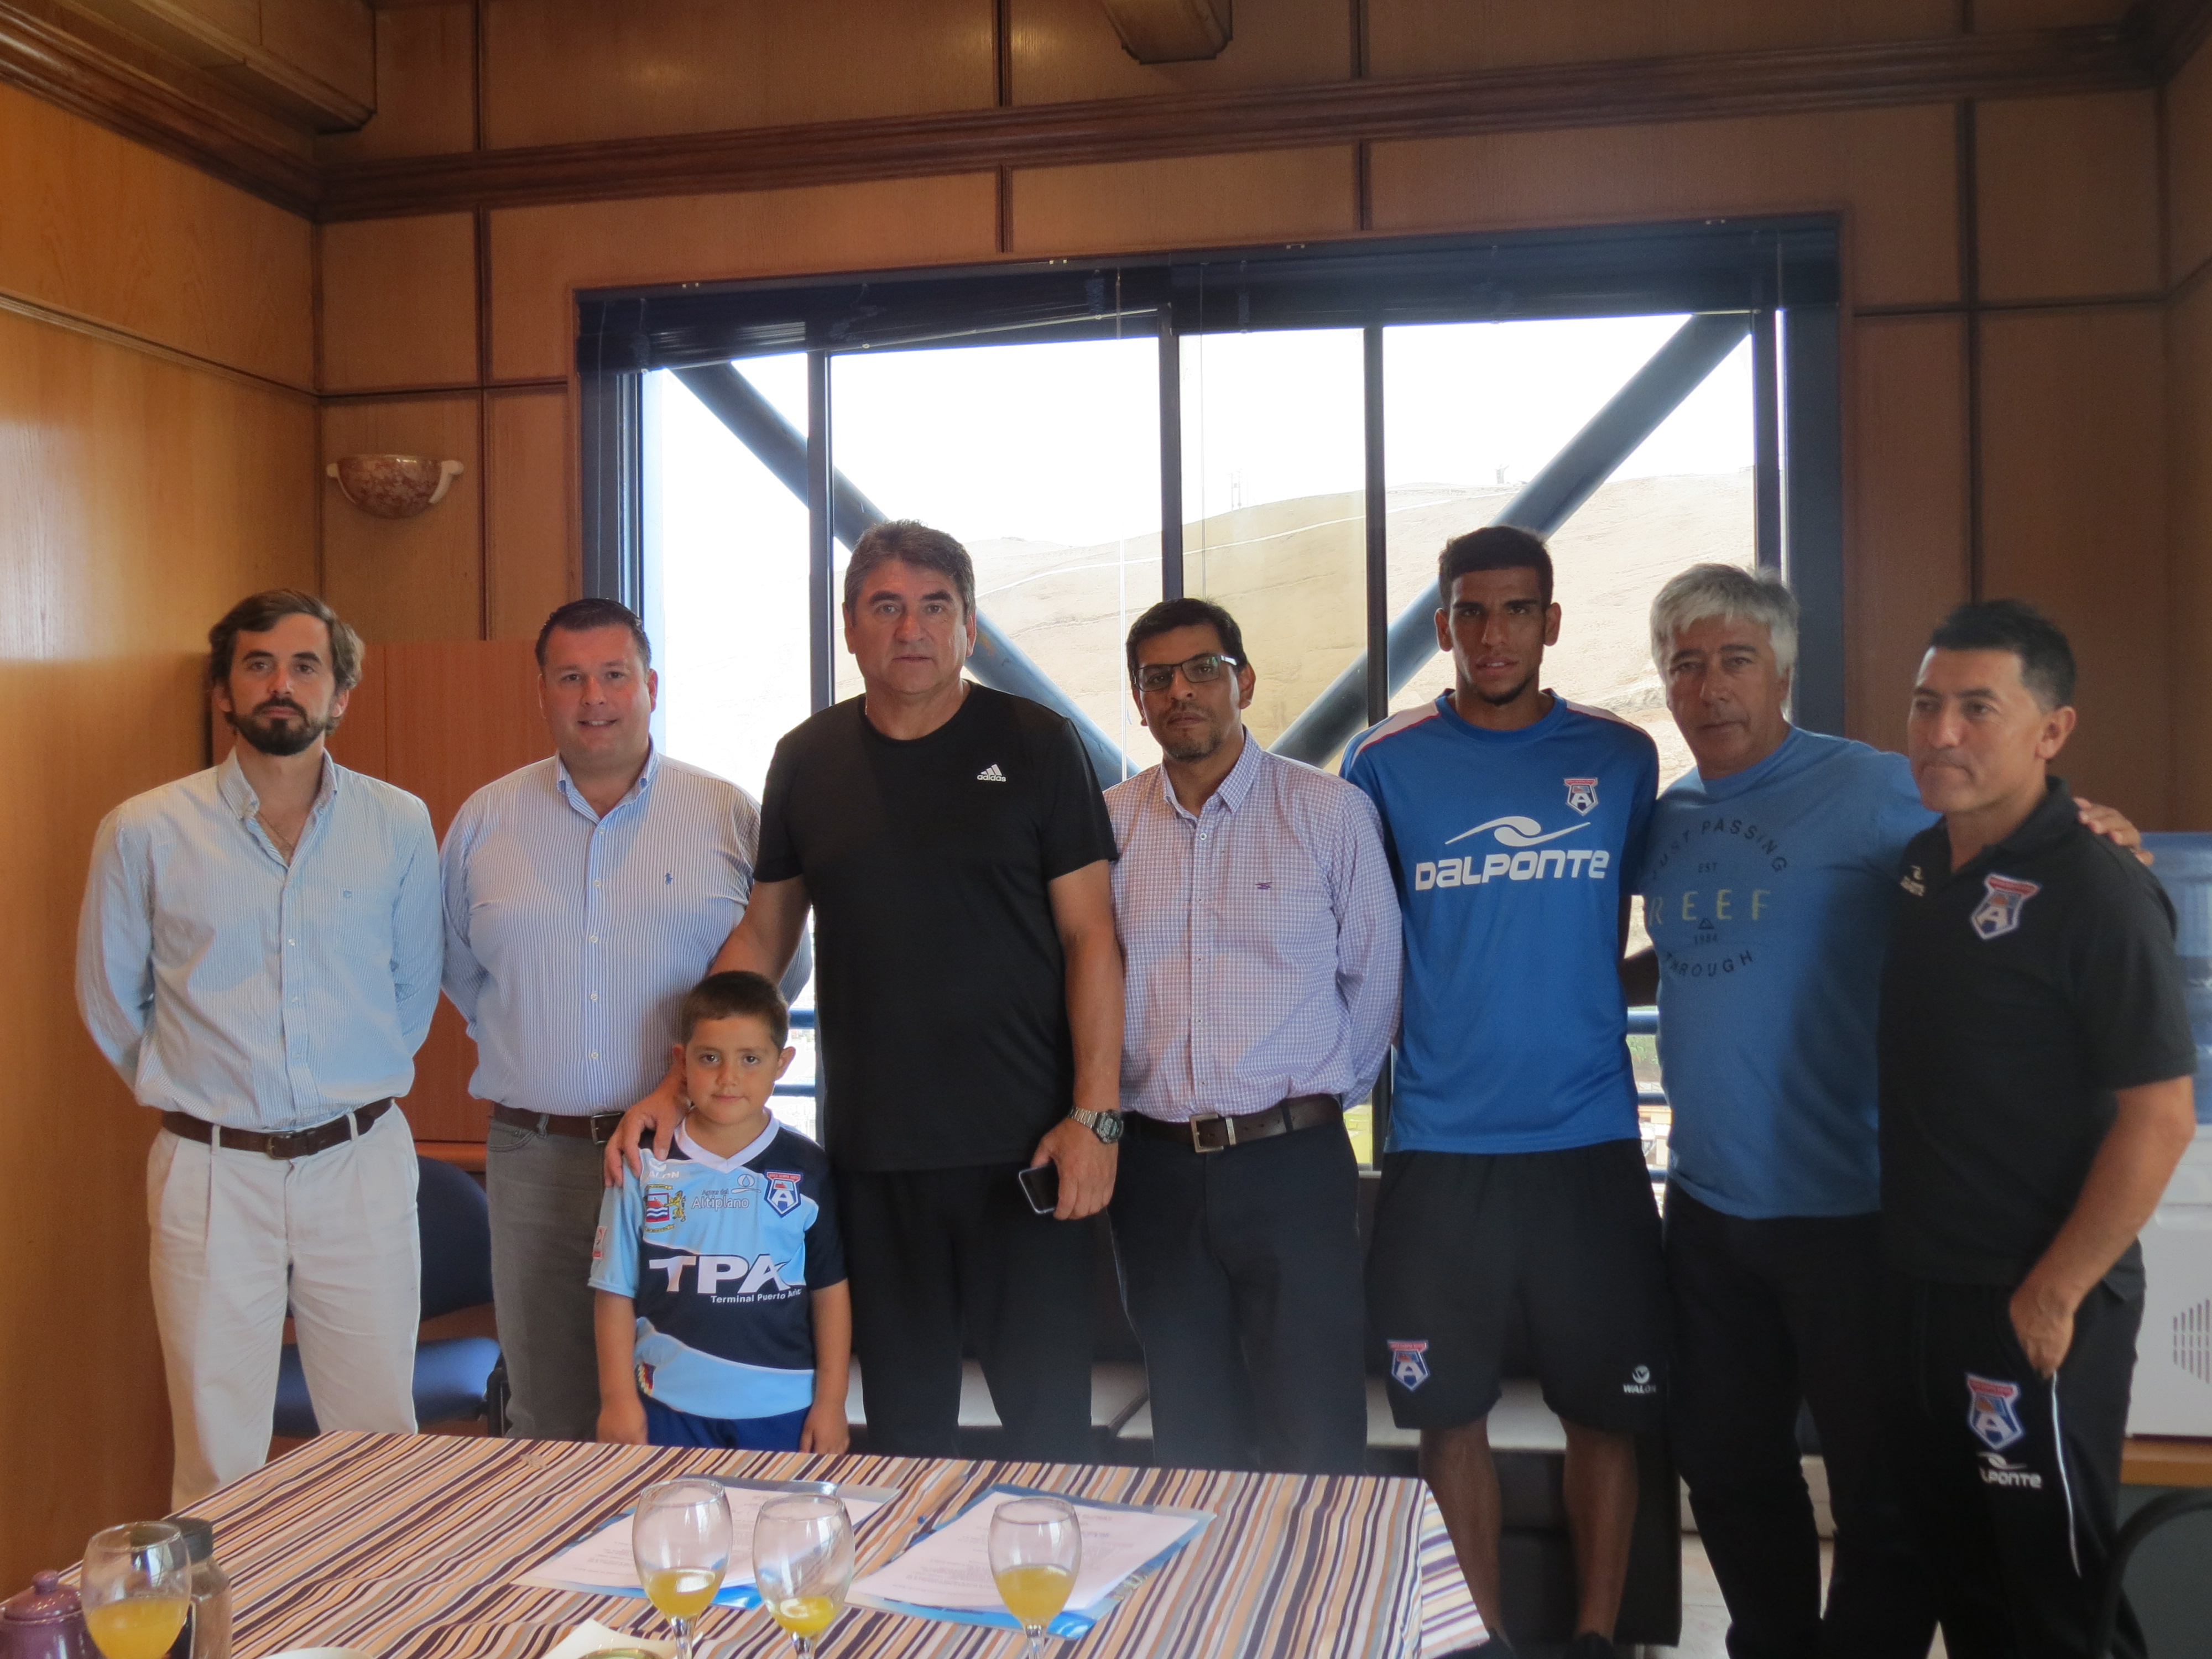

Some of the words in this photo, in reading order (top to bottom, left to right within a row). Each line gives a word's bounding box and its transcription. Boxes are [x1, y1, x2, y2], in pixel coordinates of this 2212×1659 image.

[1701, 817, 1788, 873] PASSING
[1648, 889, 1770, 926] REEF
[1665, 950, 1754, 977] THROUGH
[691, 1195, 749, 1212] Altiplano
[649, 1254, 792, 1294] TPA
[711, 1295, 754, 1303] Terminal
[757, 1293, 786, 1302] Puerto
[787, 1288, 802, 1298] Aric
